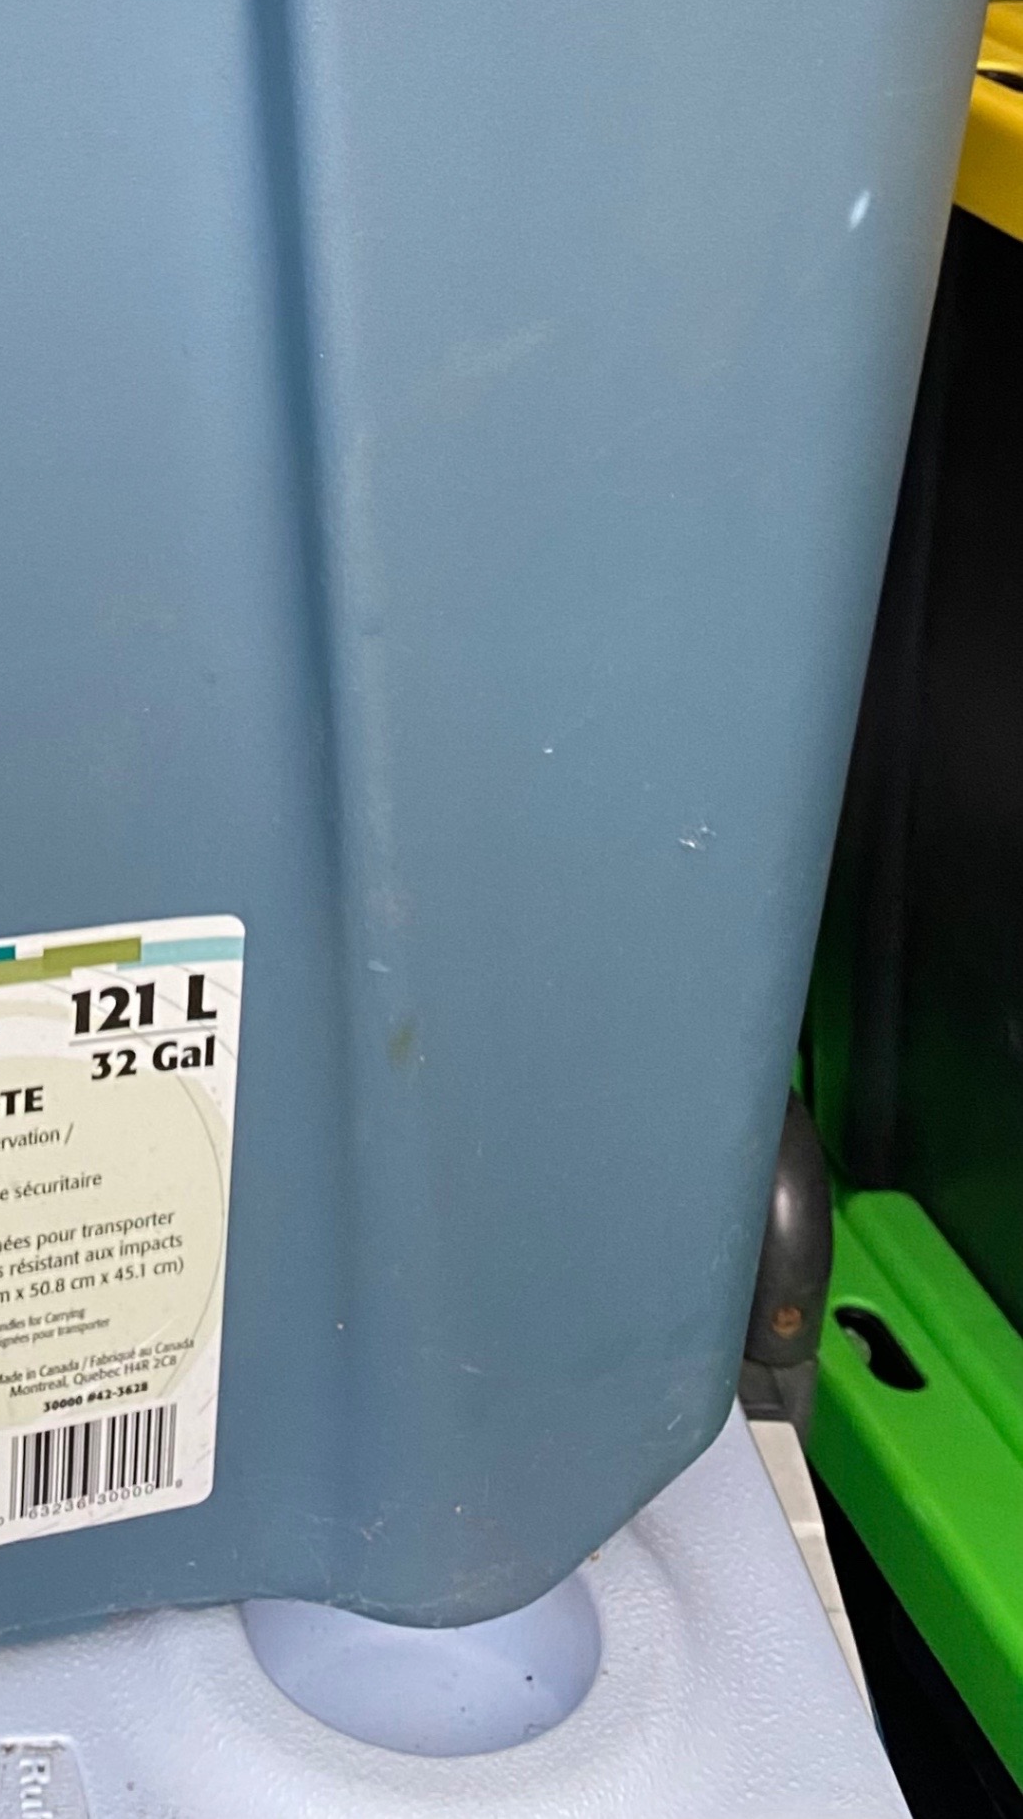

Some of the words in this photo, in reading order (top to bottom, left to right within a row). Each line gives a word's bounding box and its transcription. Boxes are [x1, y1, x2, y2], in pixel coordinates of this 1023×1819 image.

[71, 982, 155, 1034] 121
[186, 974, 217, 1021] L
[91, 1049, 137, 1081] 32
[152, 1034, 216, 1072] Gal
[14, 1171, 102, 1199] sécuritaire
[36, 1228, 77, 1250] pour
[82, 1211, 175, 1239] transporter
[9, 1252, 79, 1277] résistant
[84, 1247, 114, 1263] aux
[119, 1234, 183, 1258] impacts
[15, 1288, 24, 1300] x
[30, 1278, 66, 1297] 50.8
[71, 1274, 96, 1290] cm
[100, 1272, 109, 1285] x
[114, 1264, 147, 1282] 45.1
[153, 1257, 185, 1276] cm)
[27, 1368, 37, 1380] in
[39, 1359, 80, 1378] Canada
[90, 1347, 136, 1369] Fabriqué
[138, 1346, 152, 1357] au
[155, 1337, 194, 1355] Canada
[124, 1359, 150, 1375] H4R
[43, 1394, 83, 1413] 30000
